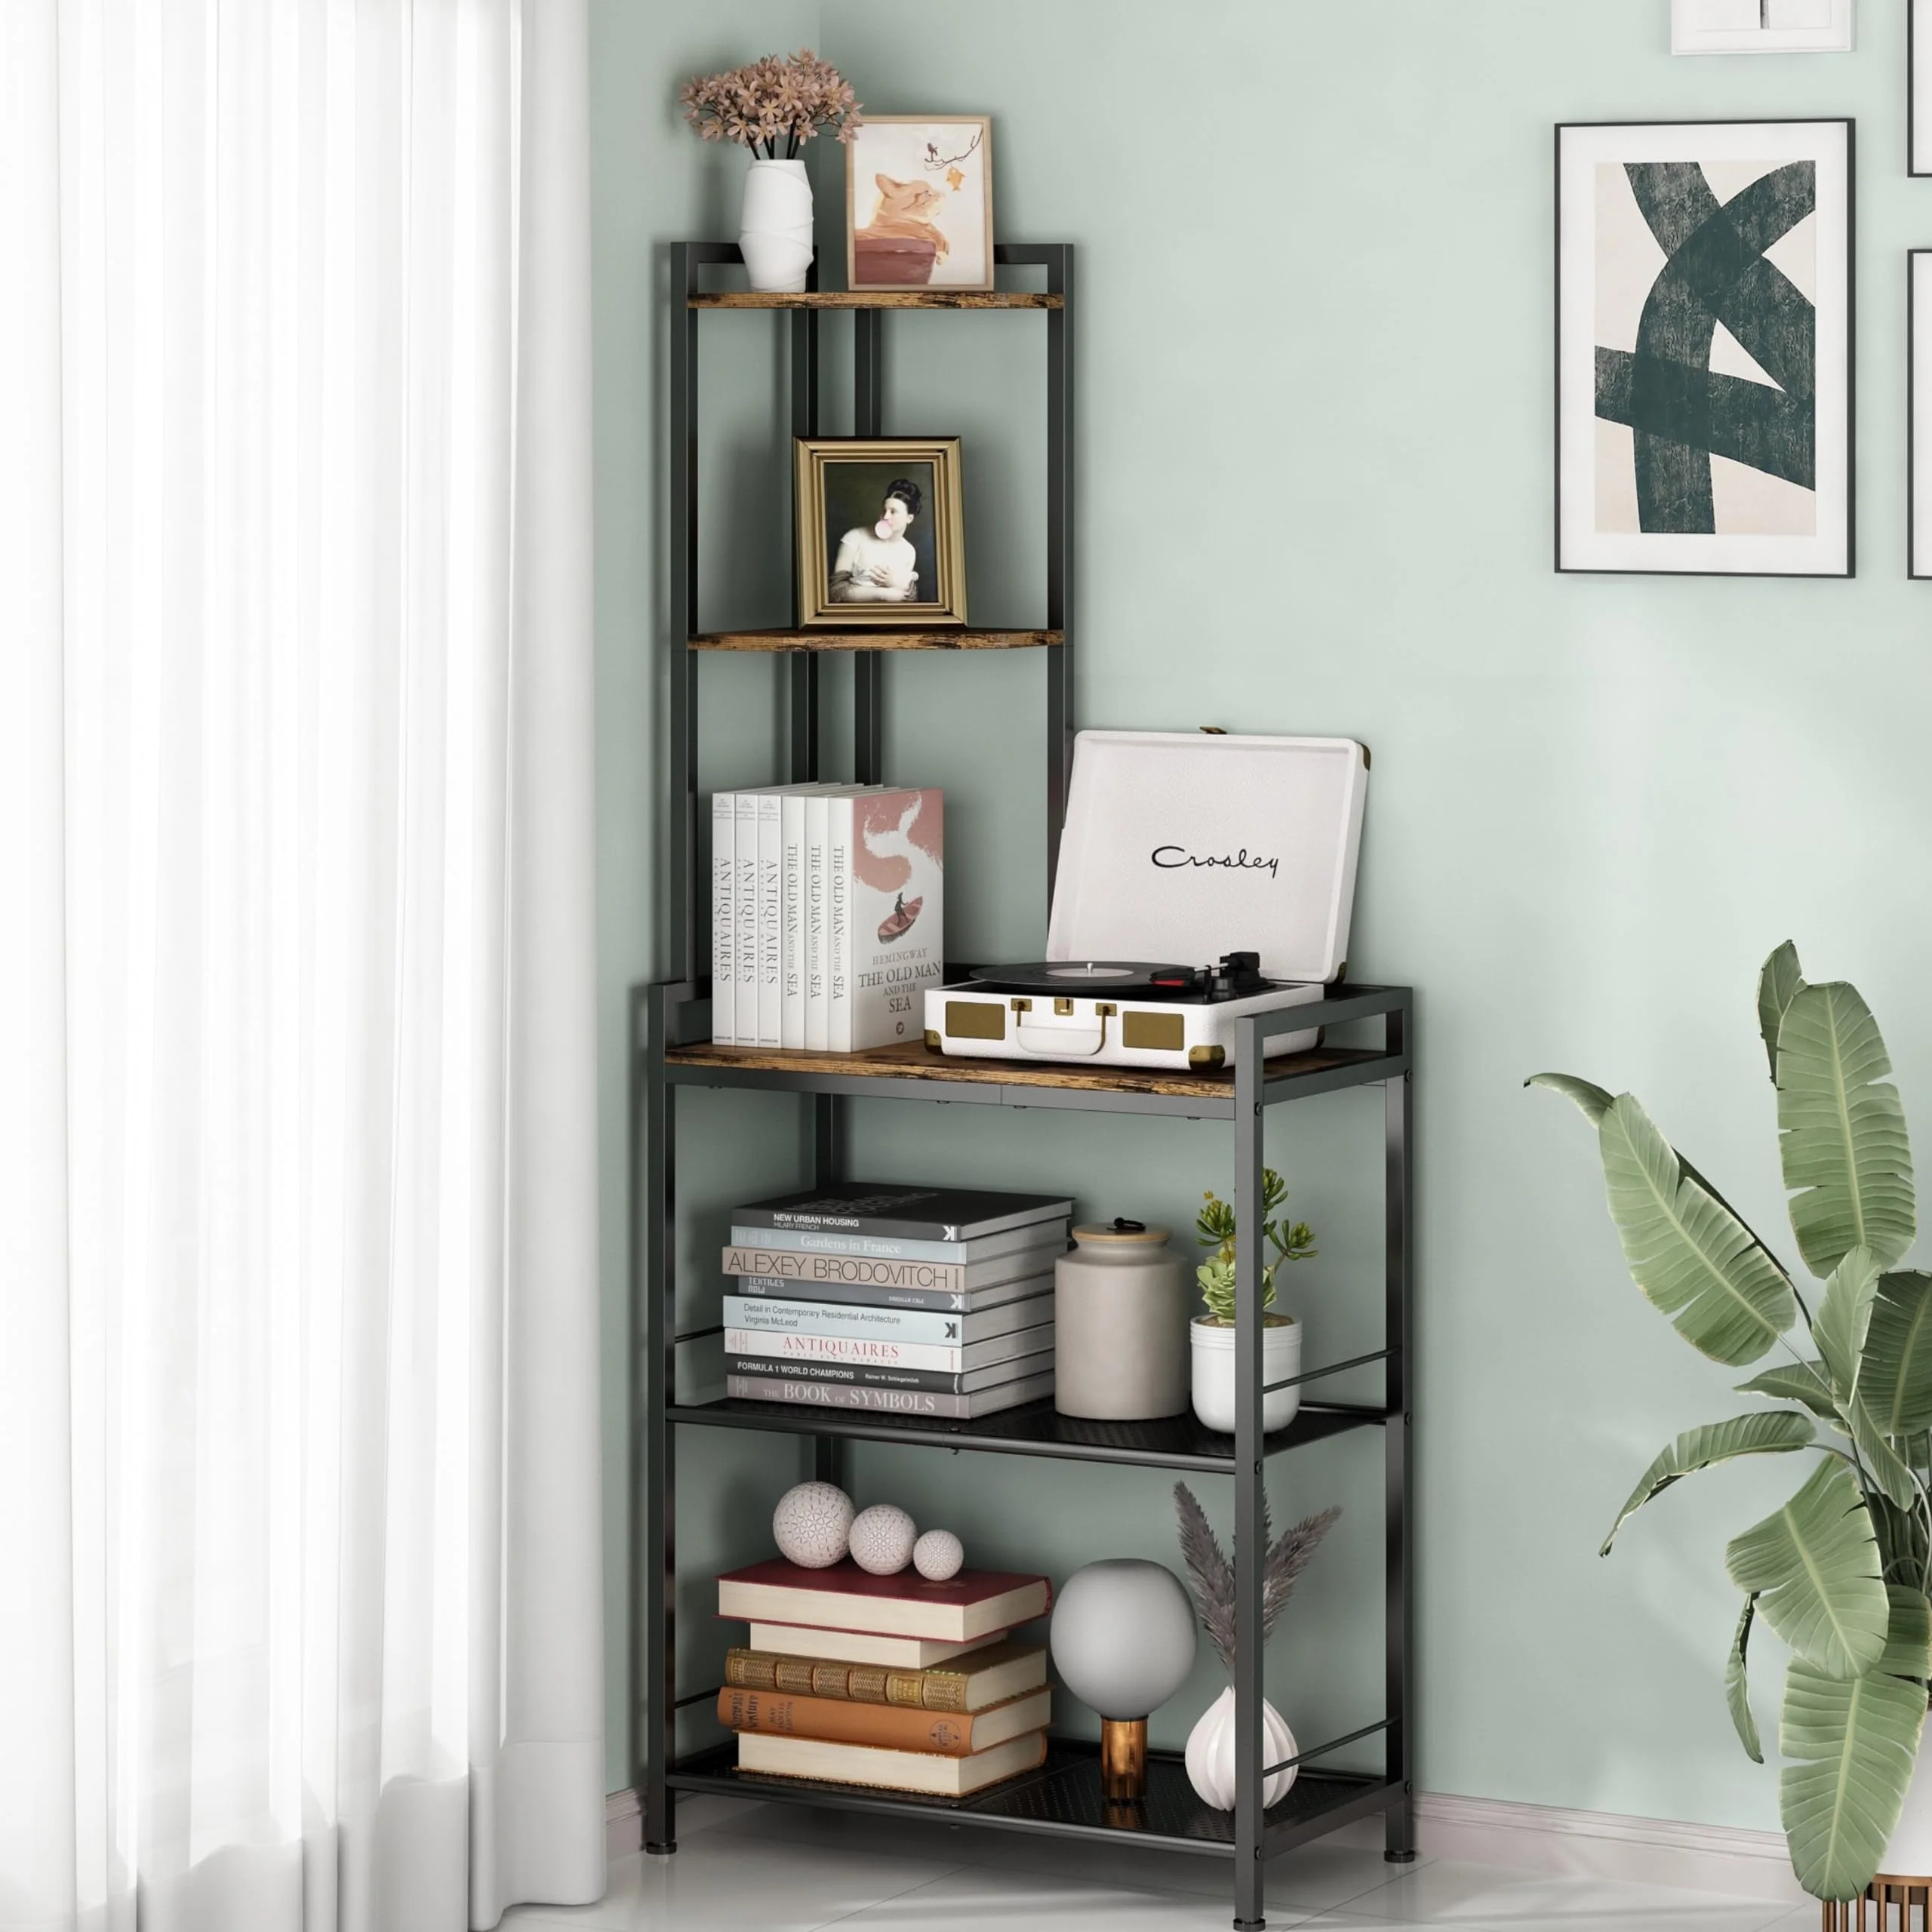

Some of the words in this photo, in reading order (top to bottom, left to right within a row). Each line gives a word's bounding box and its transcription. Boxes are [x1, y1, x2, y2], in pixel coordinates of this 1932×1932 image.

[787, 844, 798, 870] THE
[810, 844, 822, 871] THE
[833, 845, 844, 872] THE
[1151, 844, 1279, 878] Crosley
[787, 873, 798, 901] OLD
[810, 875, 822, 903] OLD
[833, 875, 844, 903] OLD
[718, 857, 731, 982] ANTIQUAIRES
[740, 858, 755, 983] ANTIQUAIRES
[763, 859, 778, 984] ANTIQUAIRES
[787, 904, 798, 934] MAN
[810, 906, 822, 934] MAN
[833, 906, 844, 936] MAN
[810, 935, 818, 953] AND
[833, 936, 841, 954] AND
[810, 954, 818, 971] THE
[833, 955, 841, 972] THE
[872, 948, 928, 966] HEMINGWAY
[787, 973, 798, 996] SEA
[810, 974, 822, 998] SEA
[833, 975, 844, 999] SEA
[858, 971, 884, 988] THE
[886, 967, 912, 983] OLD
[915, 961, 942, 979] MAN
[883, 985, 900, 997] AND
[902, 983, 916, 993] THE
[889, 995, 912, 1014] SEA
[774, 1213, 792, 1222] NEW
[793, 1215, 821, 1224] URBAN
[823, 1218, 860, 1227] HOUSING
[800, 1235, 847, 1251] Gardens
[849, 1238, 860, 1251] in
[863, 1239, 901, 1254] France
[728, 1252, 807, 1276] ALEXEY
[814, 1258, 948, 1288] BRODOVITCH
[743, 1303, 763, 1313] Detail
[764, 1305, 771, 1313] in
[772, 1306, 820, 1318] Contemporary
[821, 1310, 859, 1321] Residential
[860, 1313, 901, 1324] Architecture
[744, 1315, 770, 1325] Virginia
[771, 1317, 798, 1327] McLeod
[783, 1337, 900, 1358] ANTIQUAIRES
[737, 1361, 774, 1373] FORMULA
[780, 1365, 808, 1375] WORLD
[809, 1368, 854, 1380] CHAMPIONS
[763, 1389, 779, 1398] THE
[783, 1383, 832, 1403] BOOK
[835, 1395, 846, 1404] OF
[850, 1389, 935, 1412] SYMBOLS
